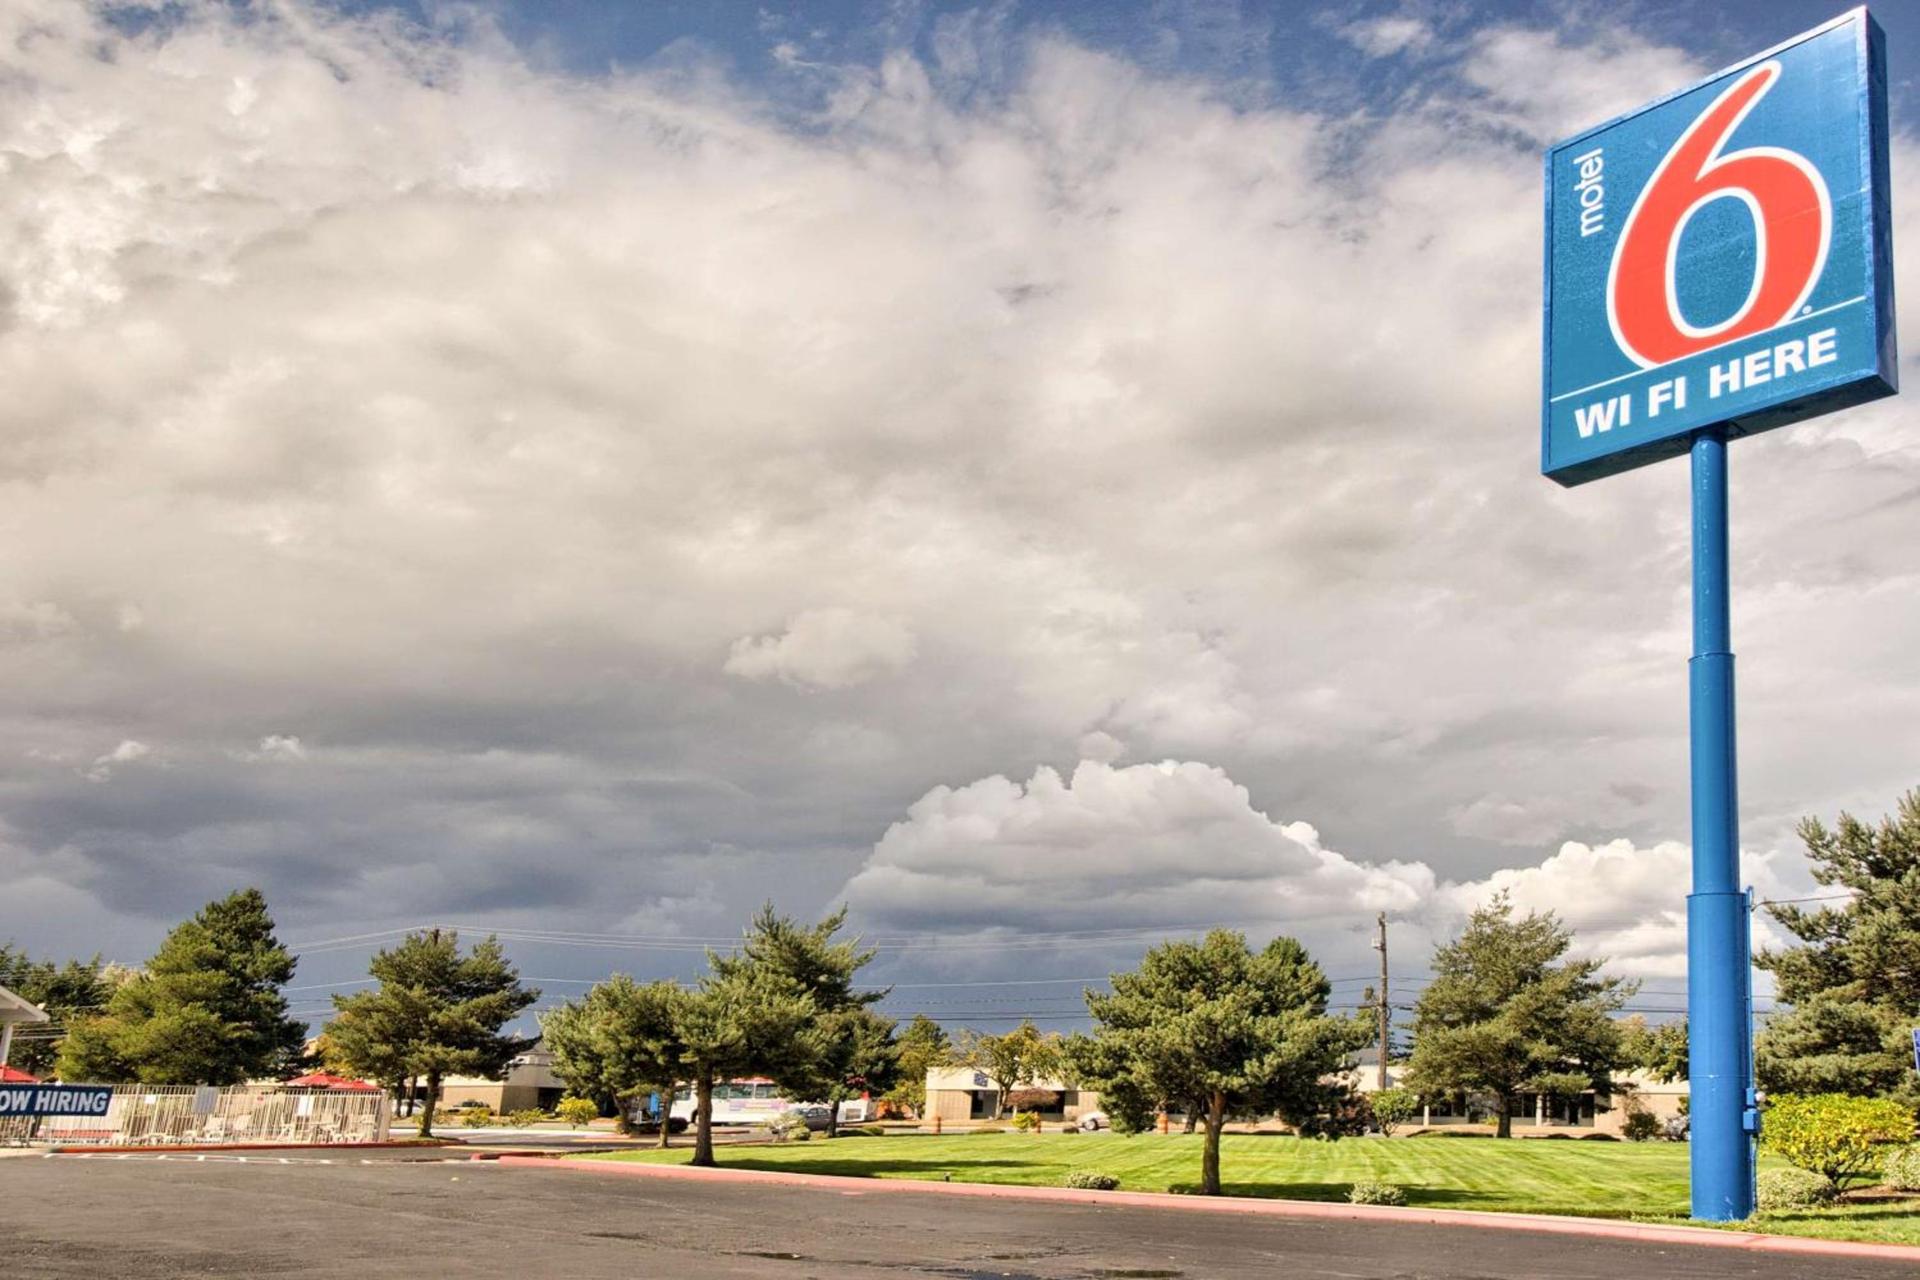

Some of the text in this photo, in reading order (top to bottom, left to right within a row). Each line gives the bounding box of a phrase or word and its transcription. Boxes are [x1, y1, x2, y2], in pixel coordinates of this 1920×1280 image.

[1573, 148, 1604, 237] motel
[1606, 59, 1832, 370] 6
[1574, 327, 1838, 438] WI FI HERE
[34, 1090, 108, 1112] HIRING
